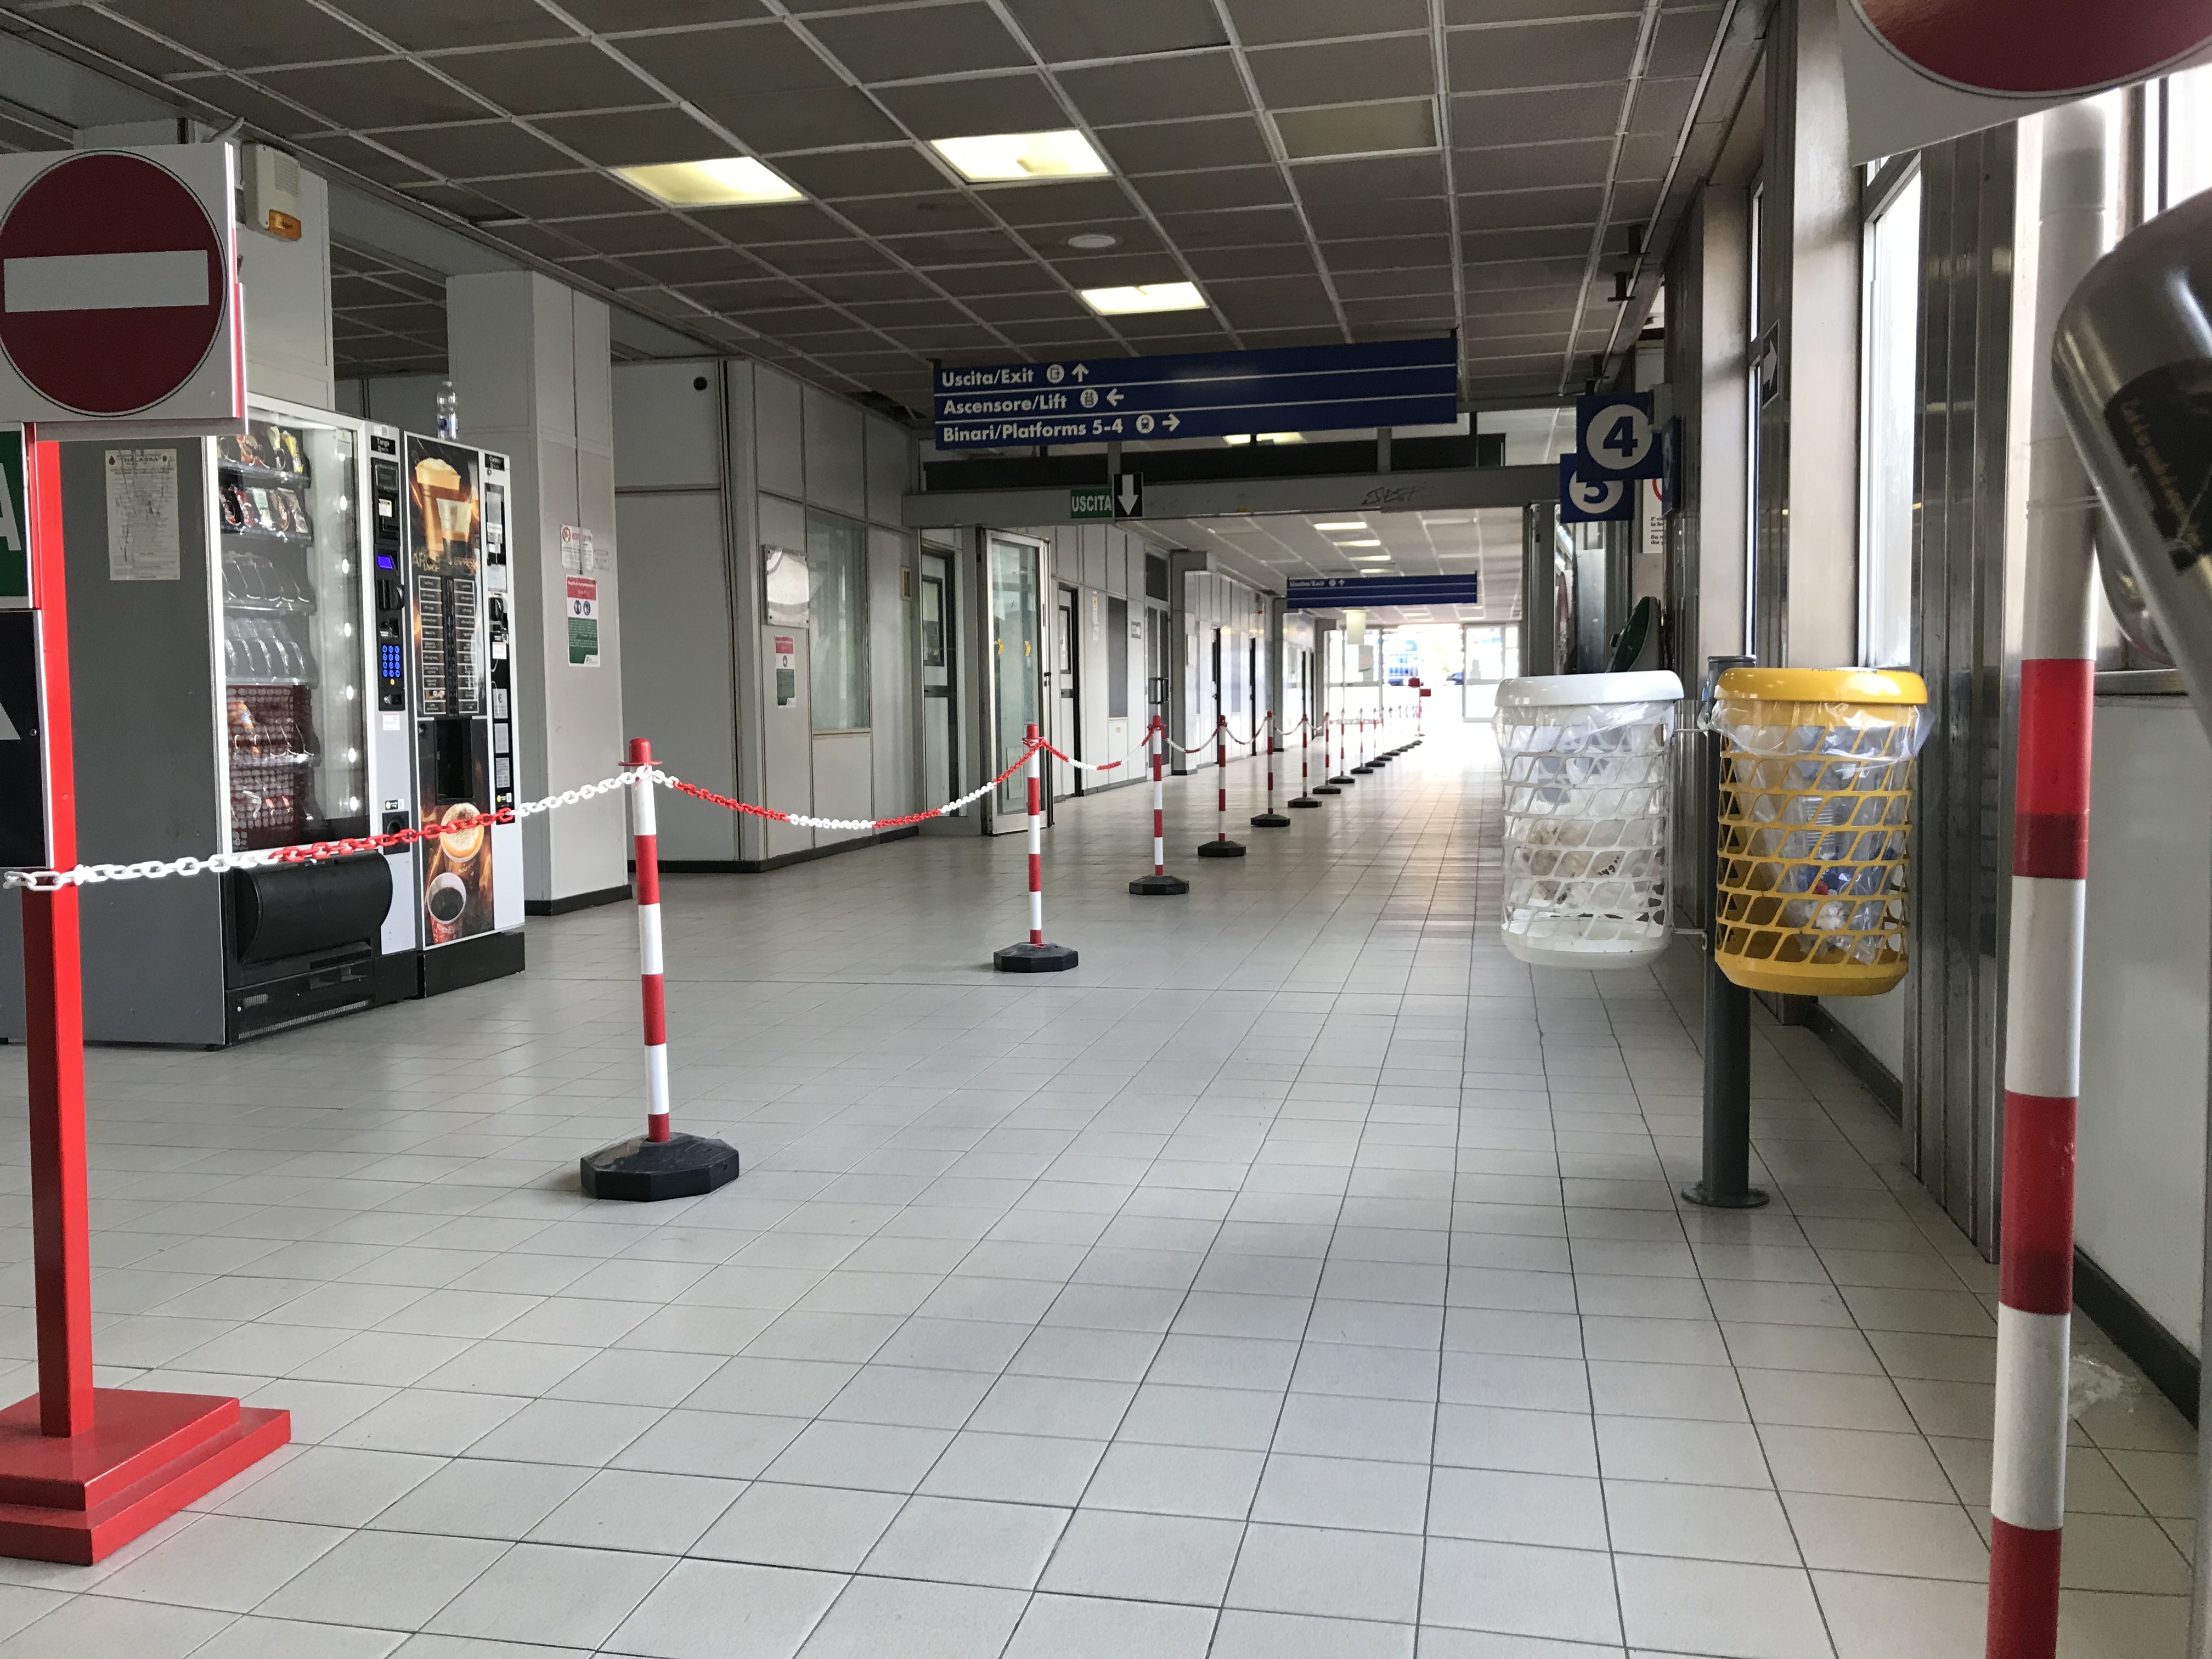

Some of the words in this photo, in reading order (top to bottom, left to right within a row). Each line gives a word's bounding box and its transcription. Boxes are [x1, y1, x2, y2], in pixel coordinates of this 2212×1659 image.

[941, 368, 1034, 387] Uscita/Exit
[943, 393, 1068, 415] Ascensore/Lift
[943, 421, 1086, 443] Binari/Platforms
[1092, 419, 1124, 435] 5-4
[1602, 415, 1638, 458] 4
[1071, 495, 1112, 512] USCITA
